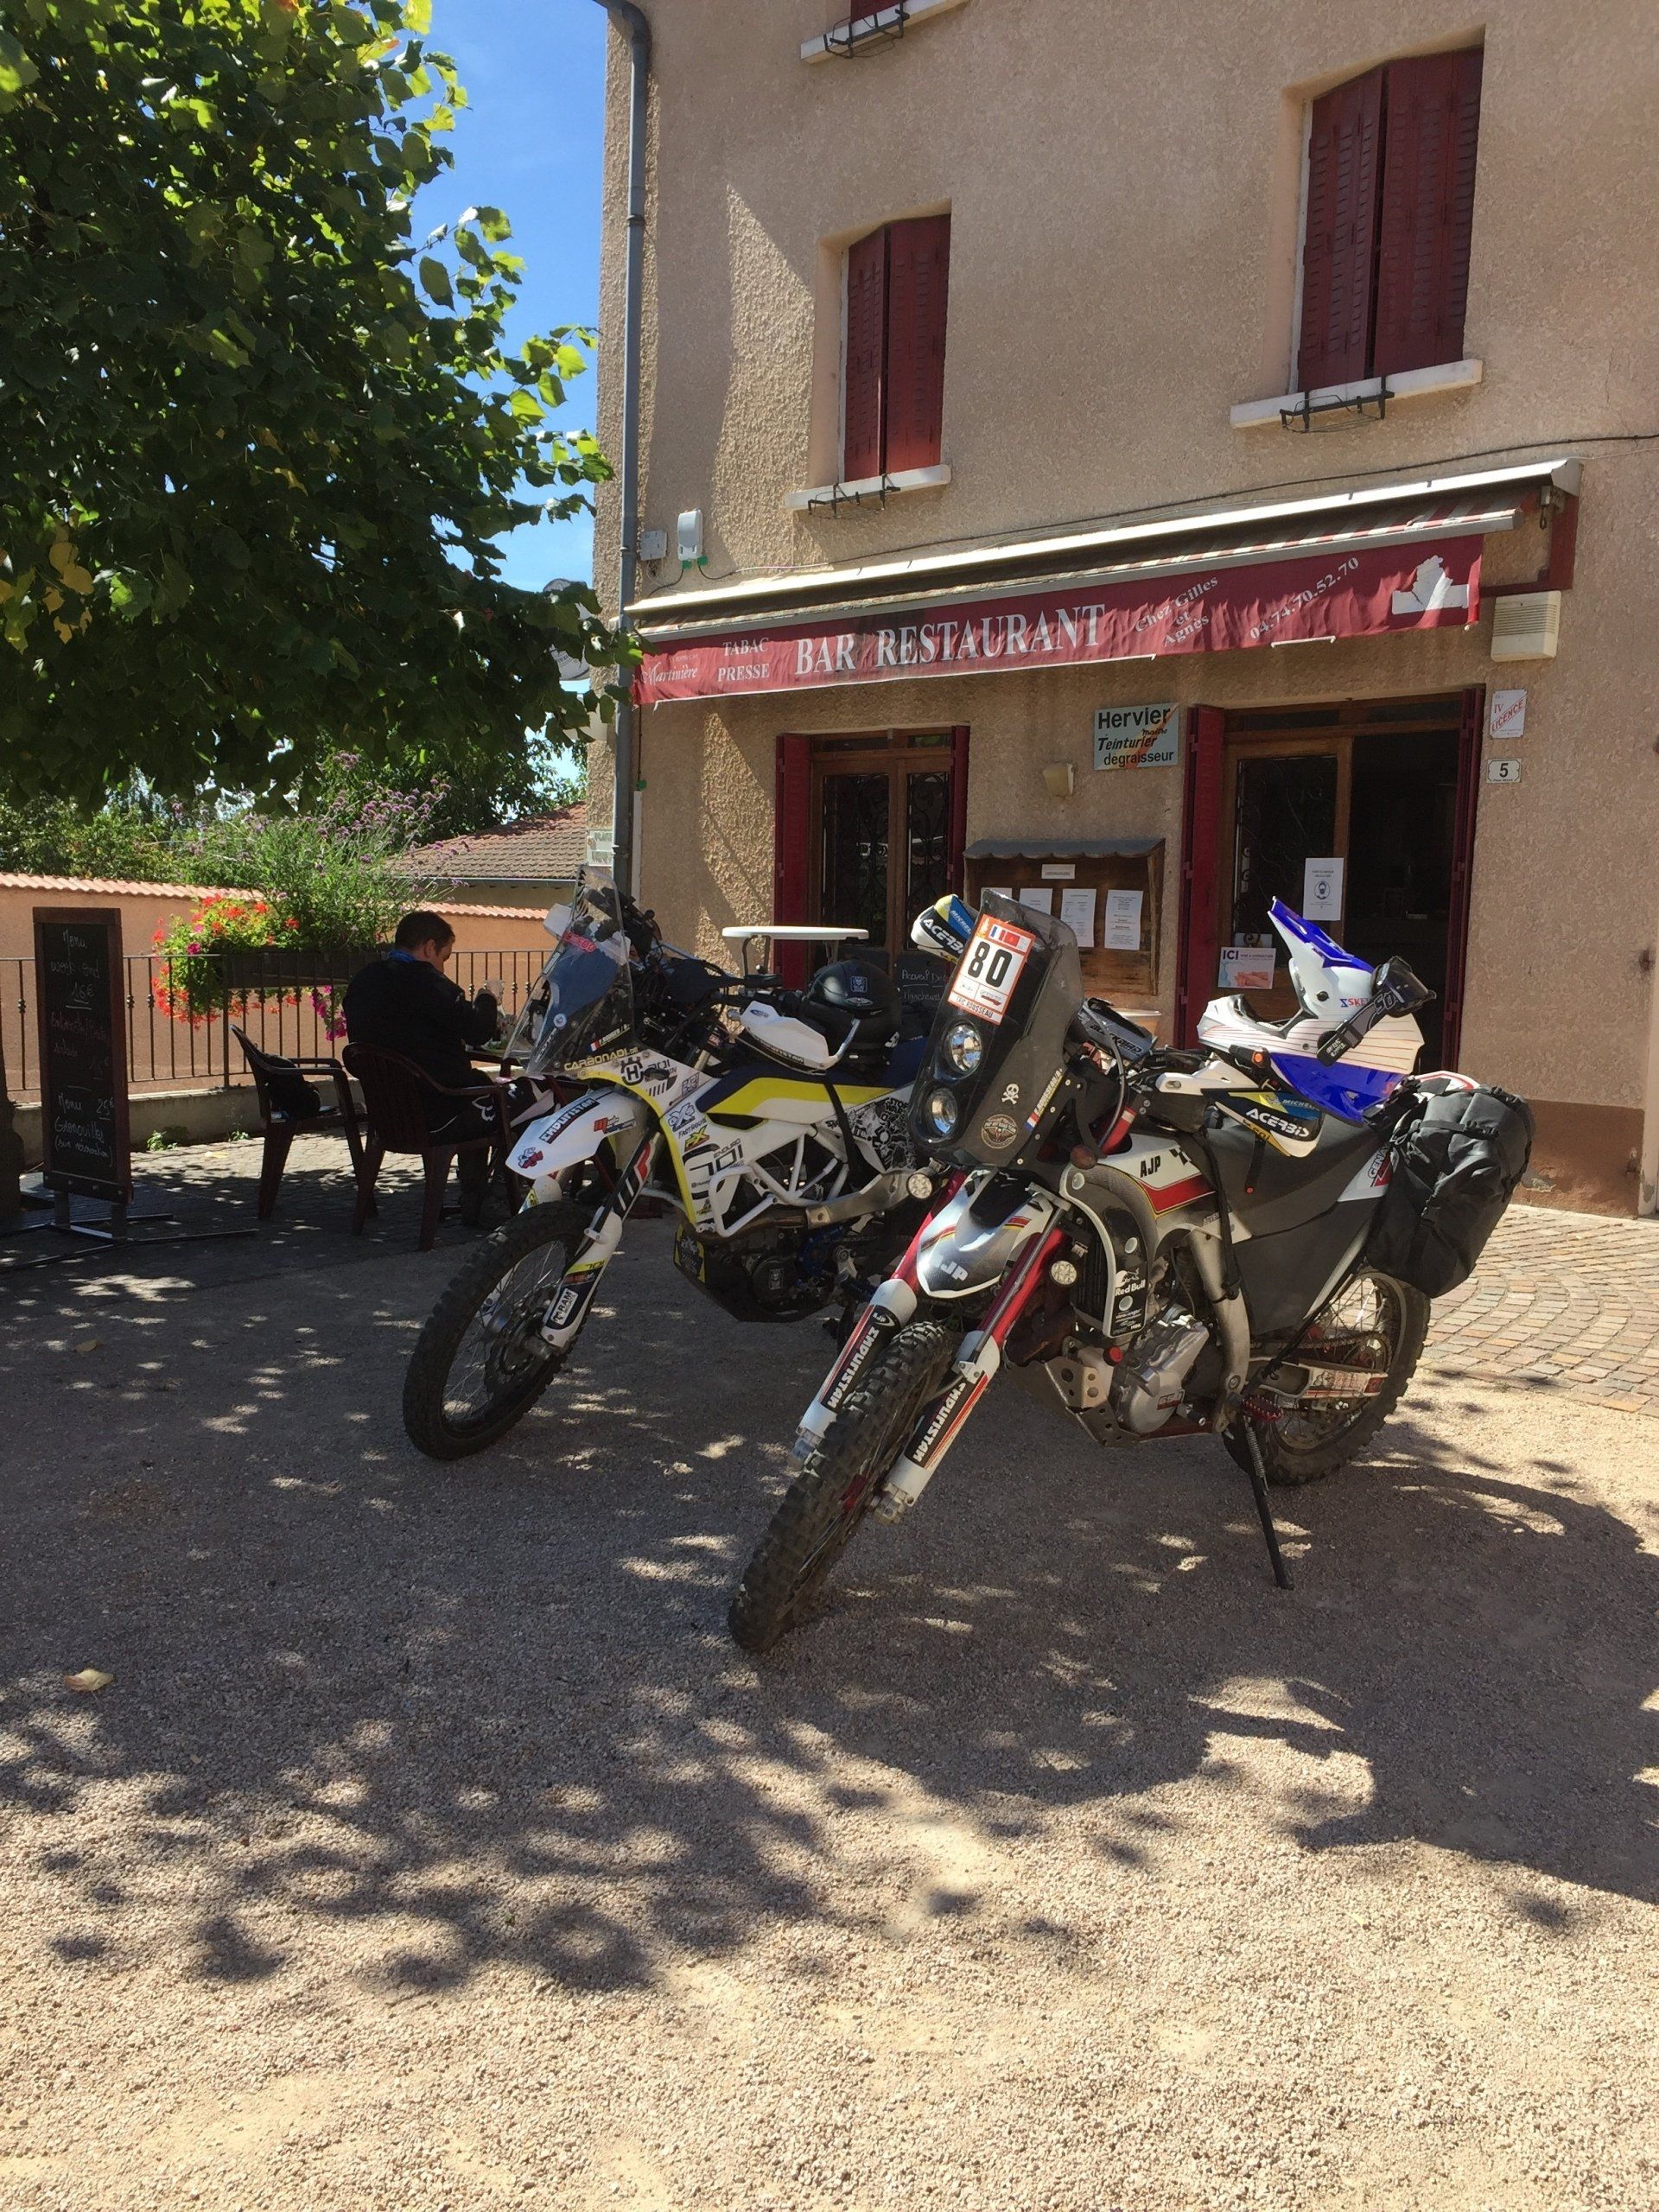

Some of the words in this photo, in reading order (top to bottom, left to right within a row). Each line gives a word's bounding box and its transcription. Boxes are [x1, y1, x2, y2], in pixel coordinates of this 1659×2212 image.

[1135, 605, 1173, 633] Chez
[1173, 576, 1219, 607] Gilles
[1249, 557, 1359, 639] 04.74.70.52.70
[1175, 612, 1191, 626] et
[794, 633, 857, 676] BAR
[874, 603, 1106, 669] RESTAURANT
[1164, 614, 1210, 647] Agnès
[722, 637, 770, 657] TABAC
[717, 663, 770, 683] PRESSE
[1097, 707, 1171, 730] Hervier
[1491, 698, 1523, 732] LICENCE
[1097, 735, 1158, 752] Teinturier
[1499, 762, 1510, 779] 5
[967, 941, 1013, 988] 80
[1223, 950, 1239, 960] ICI
[965, 1001, 995, 1019] ROUSSEAU
[1140, 1155, 1161, 1179] AJP
[1115, 1284, 1131, 1297] Red
[1131, 1278, 1147, 1292] Bull
[558, 1291, 573, 1310] RAM
